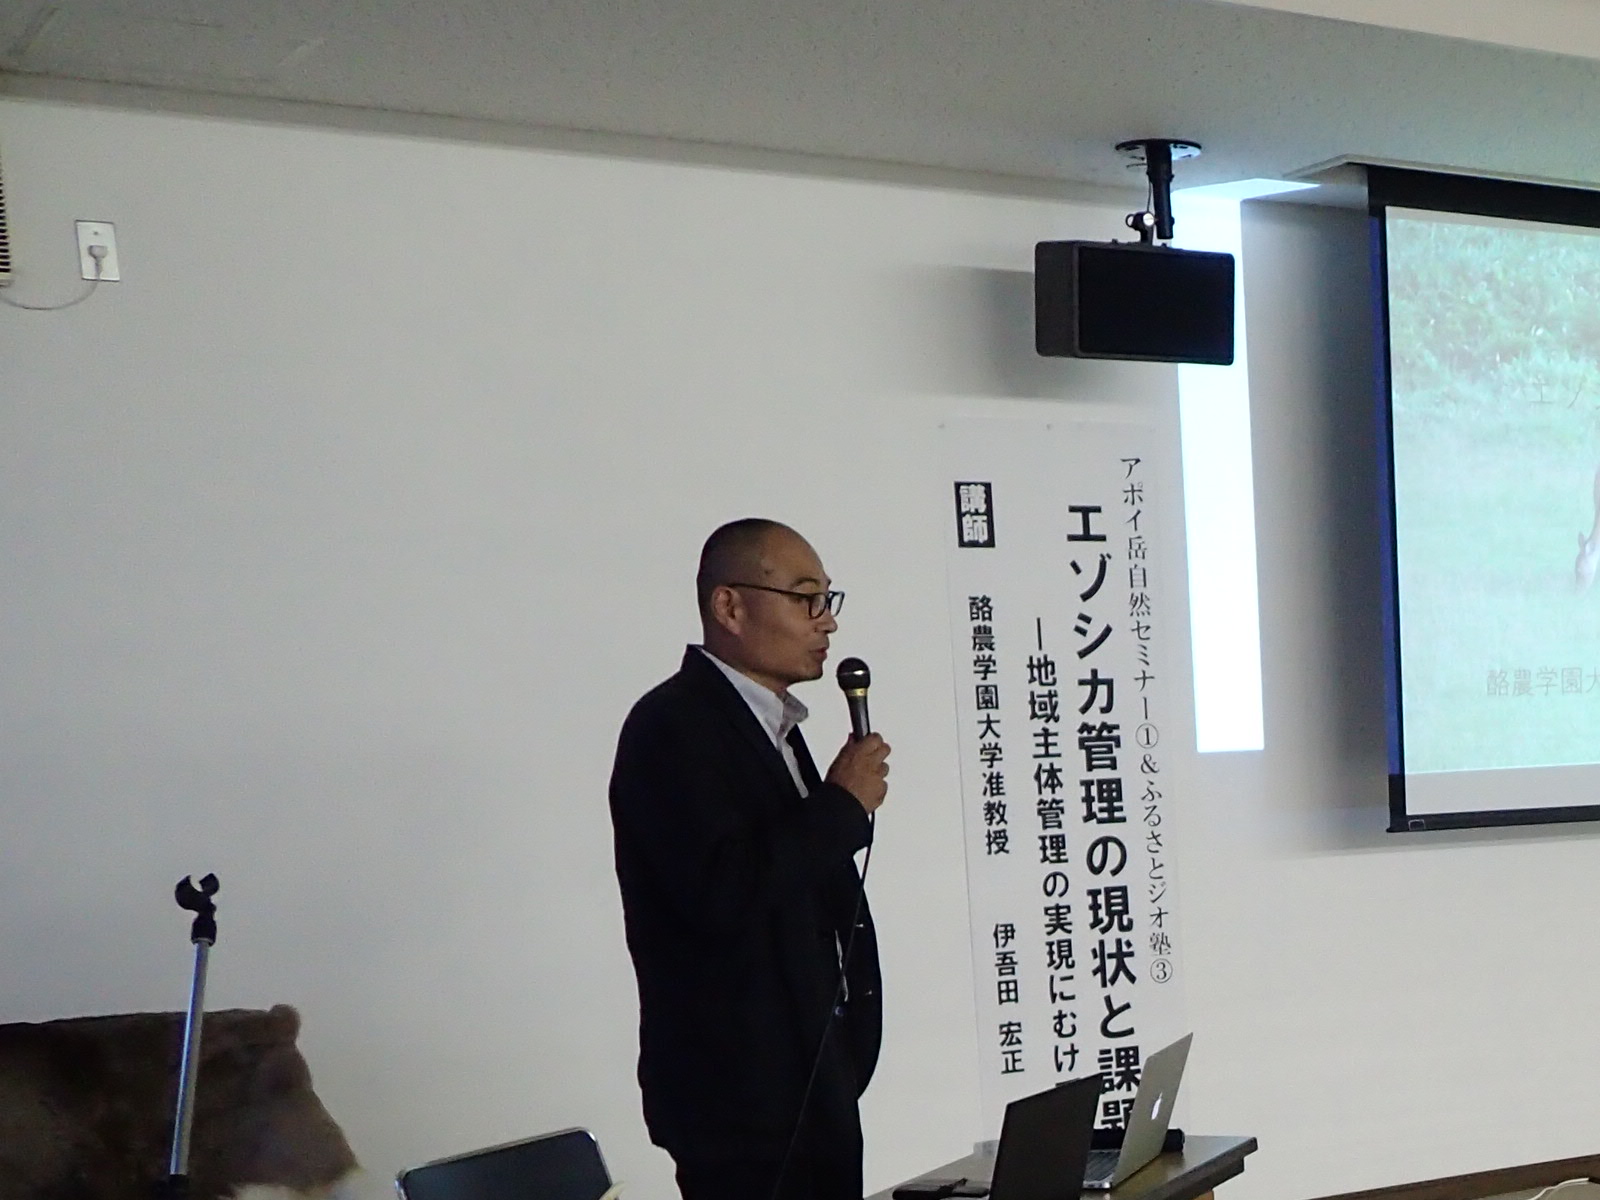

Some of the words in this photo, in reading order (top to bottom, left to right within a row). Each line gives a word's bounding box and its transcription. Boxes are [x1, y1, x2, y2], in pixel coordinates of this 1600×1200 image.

[958, 482, 990, 546] 講師
[968, 594, 1010, 856] 酪農学園大学准教授
[992, 922, 1020, 1006] 伊吾田
[998, 1021, 1025, 1075] 宏正
